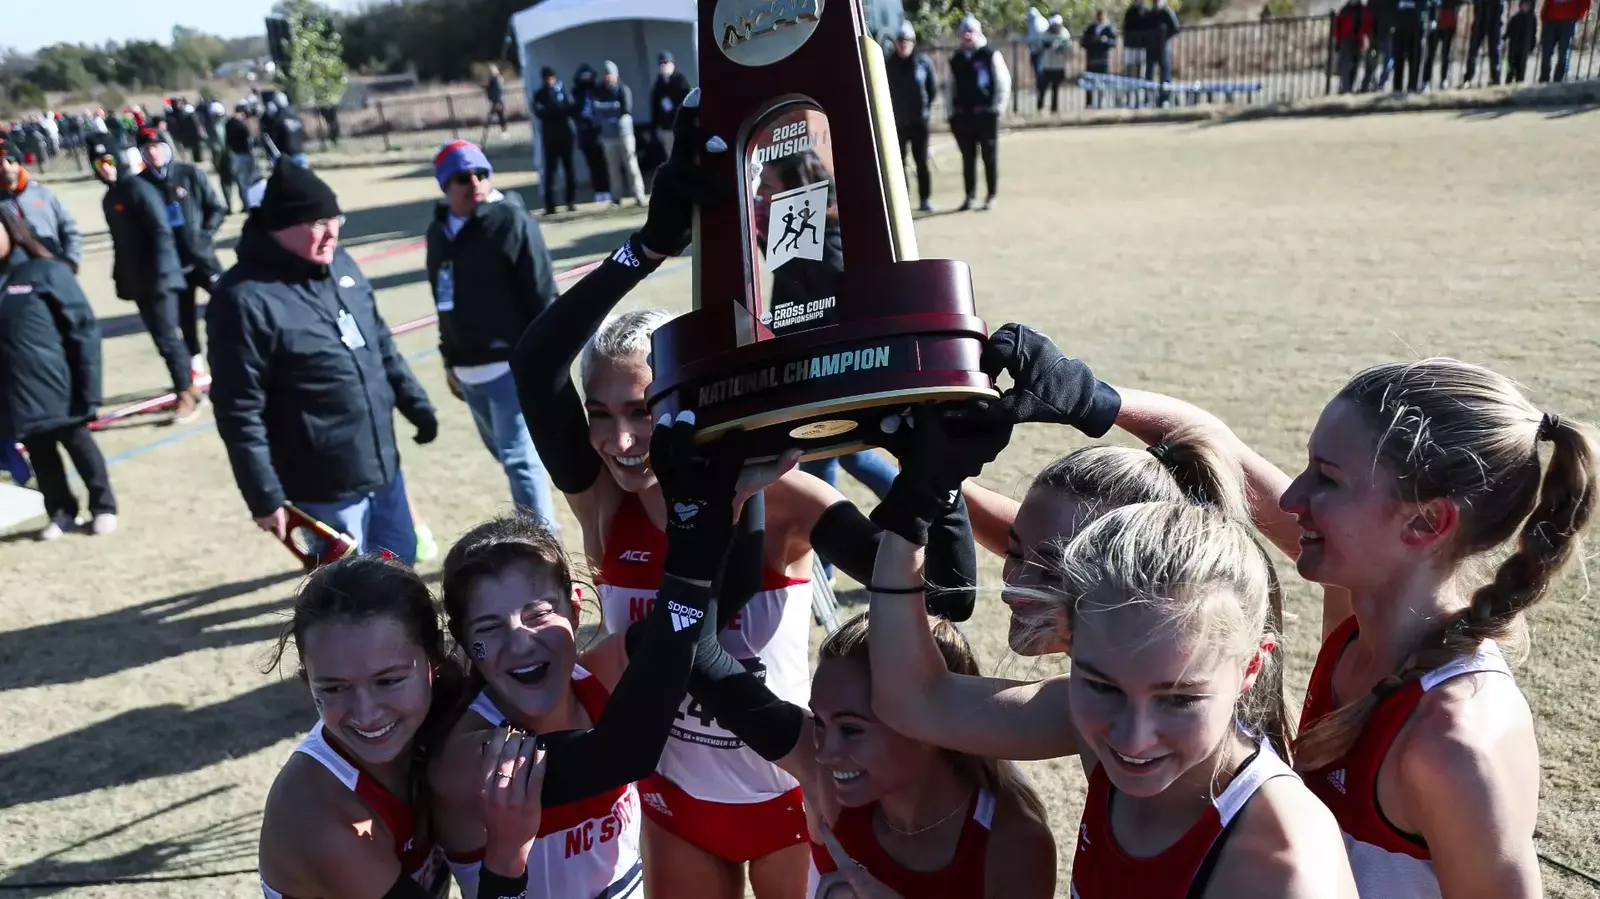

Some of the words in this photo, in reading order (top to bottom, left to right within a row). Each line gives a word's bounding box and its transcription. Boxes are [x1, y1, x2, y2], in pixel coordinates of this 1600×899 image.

[772, 120, 807, 142] 2022
[757, 132, 818, 163] DIVISION
[774, 304, 805, 320] CROSS
[806, 296, 836, 313] COUNT
[773, 310, 824, 329] CHAMPIONSHIPS
[699, 366, 779, 407] NATIONAL
[783, 345, 890, 384] CHAMPION
[619, 550, 652, 562] ACC
[667, 600, 704, 619] adidas
[695, 735, 728, 747] NOVEMBER
[564, 821, 594, 859] NC
[599, 792, 634, 843] STAT
